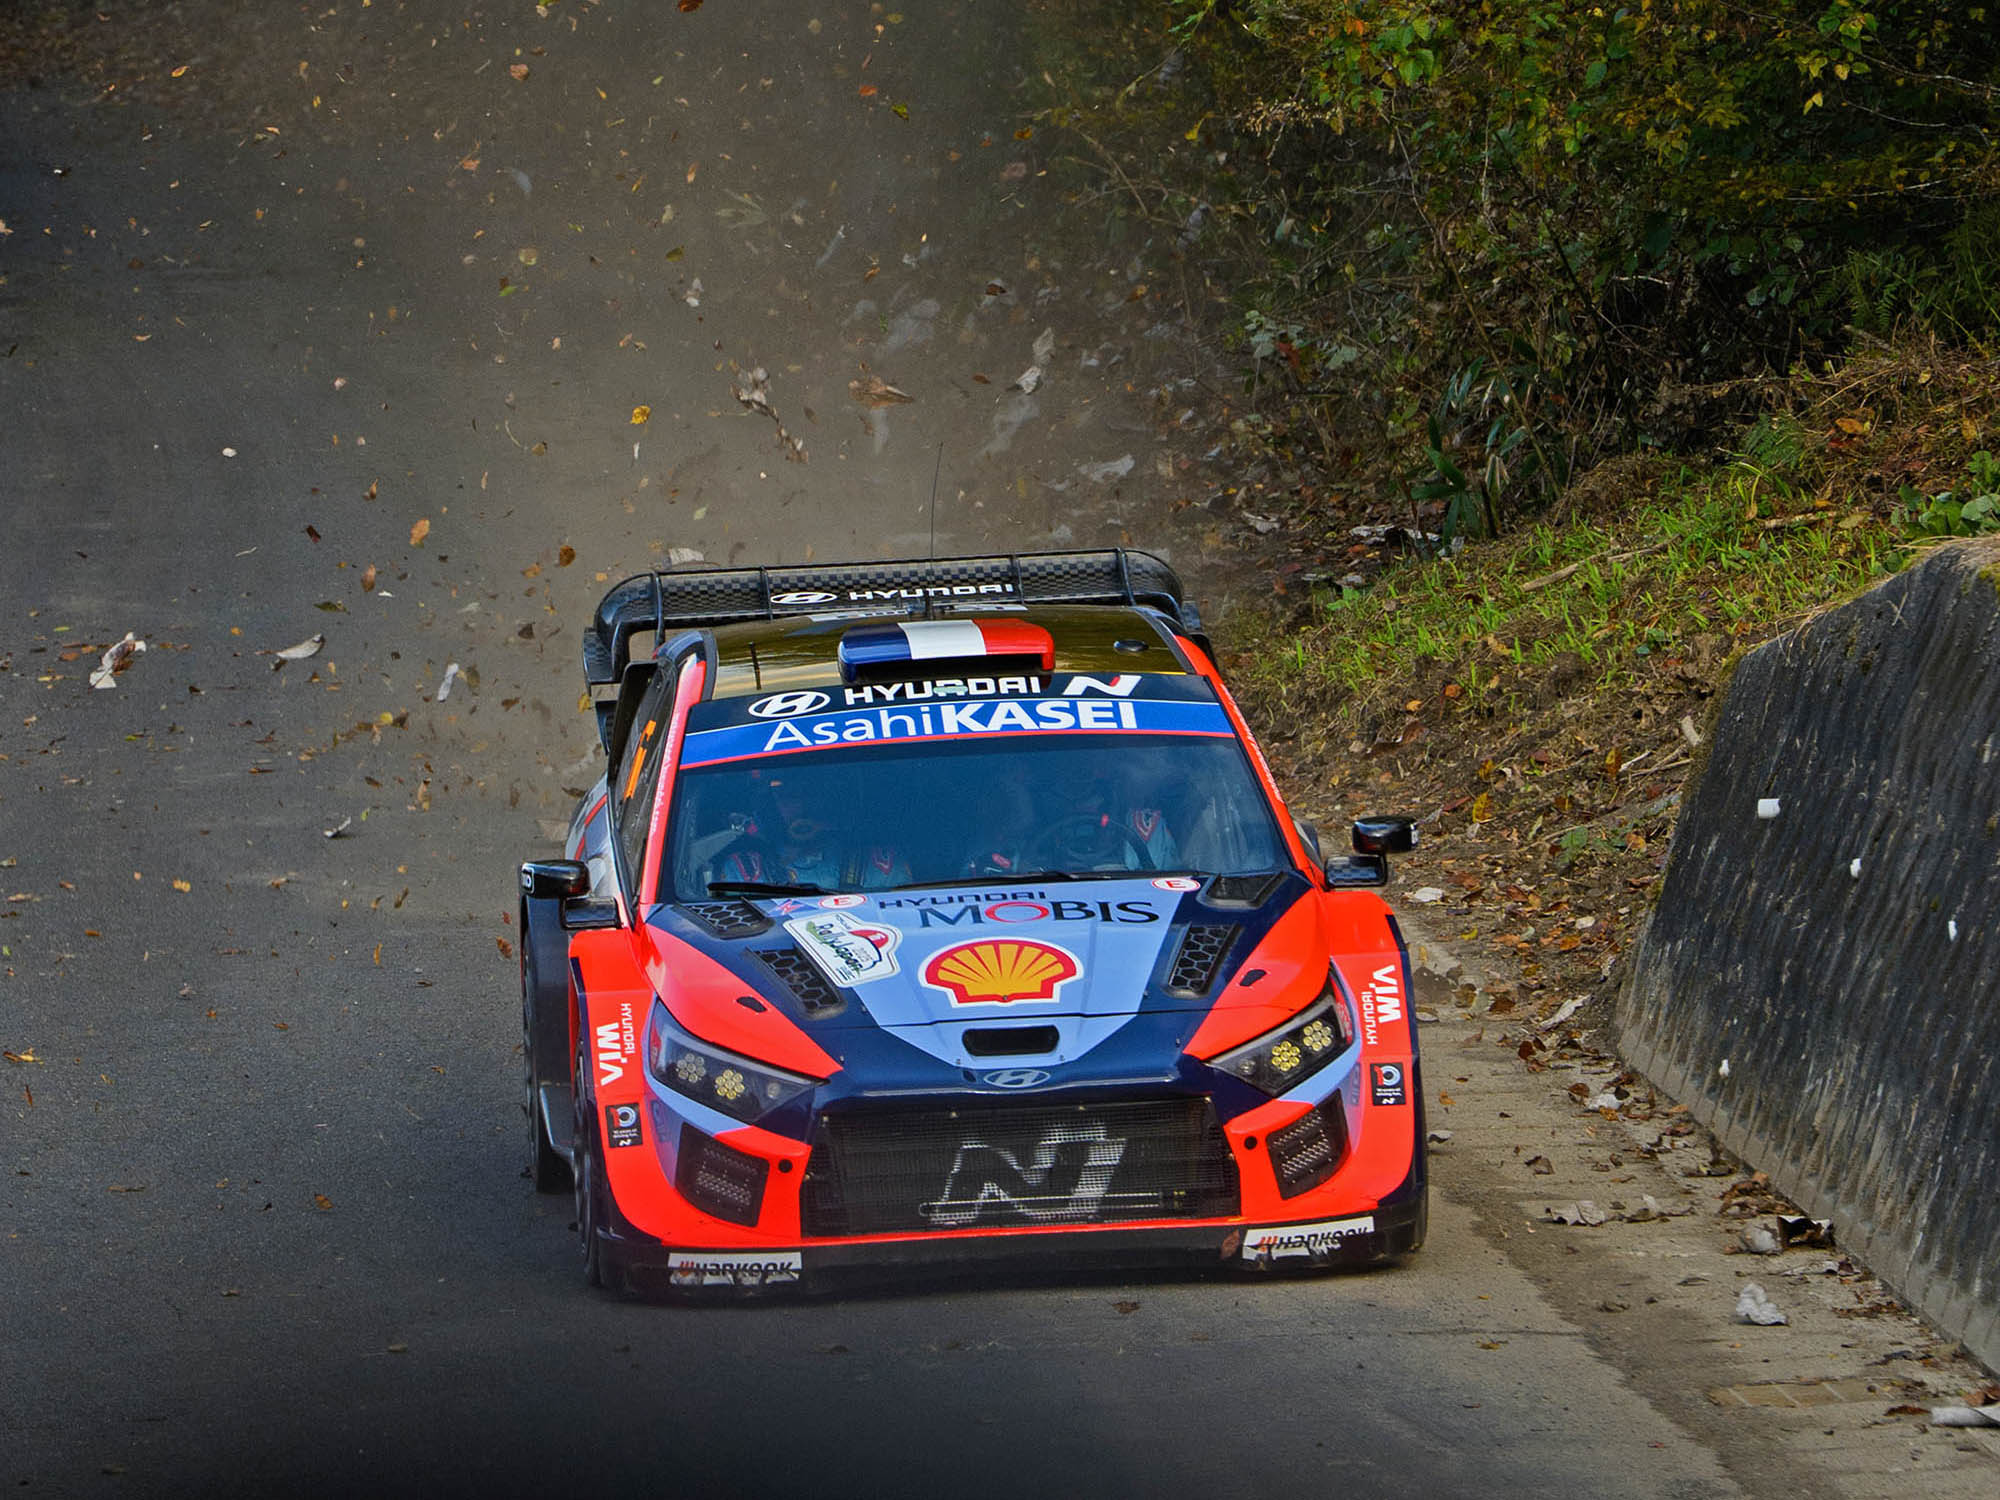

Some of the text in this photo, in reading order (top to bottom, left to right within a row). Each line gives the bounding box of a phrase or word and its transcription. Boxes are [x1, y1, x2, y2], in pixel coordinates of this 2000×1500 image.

[849, 584, 1014, 600] HYUNDAI
[763, 701, 1138, 751] AsahiKASEI
[1165, 880, 1187, 889] E
[878, 891, 1046, 909] HYUNDAI
[919, 901, 1160, 928] MOBIS
[620, 1003, 636, 1054] HYUNDAI
[1361, 991, 1378, 1045] HYUNDAI
